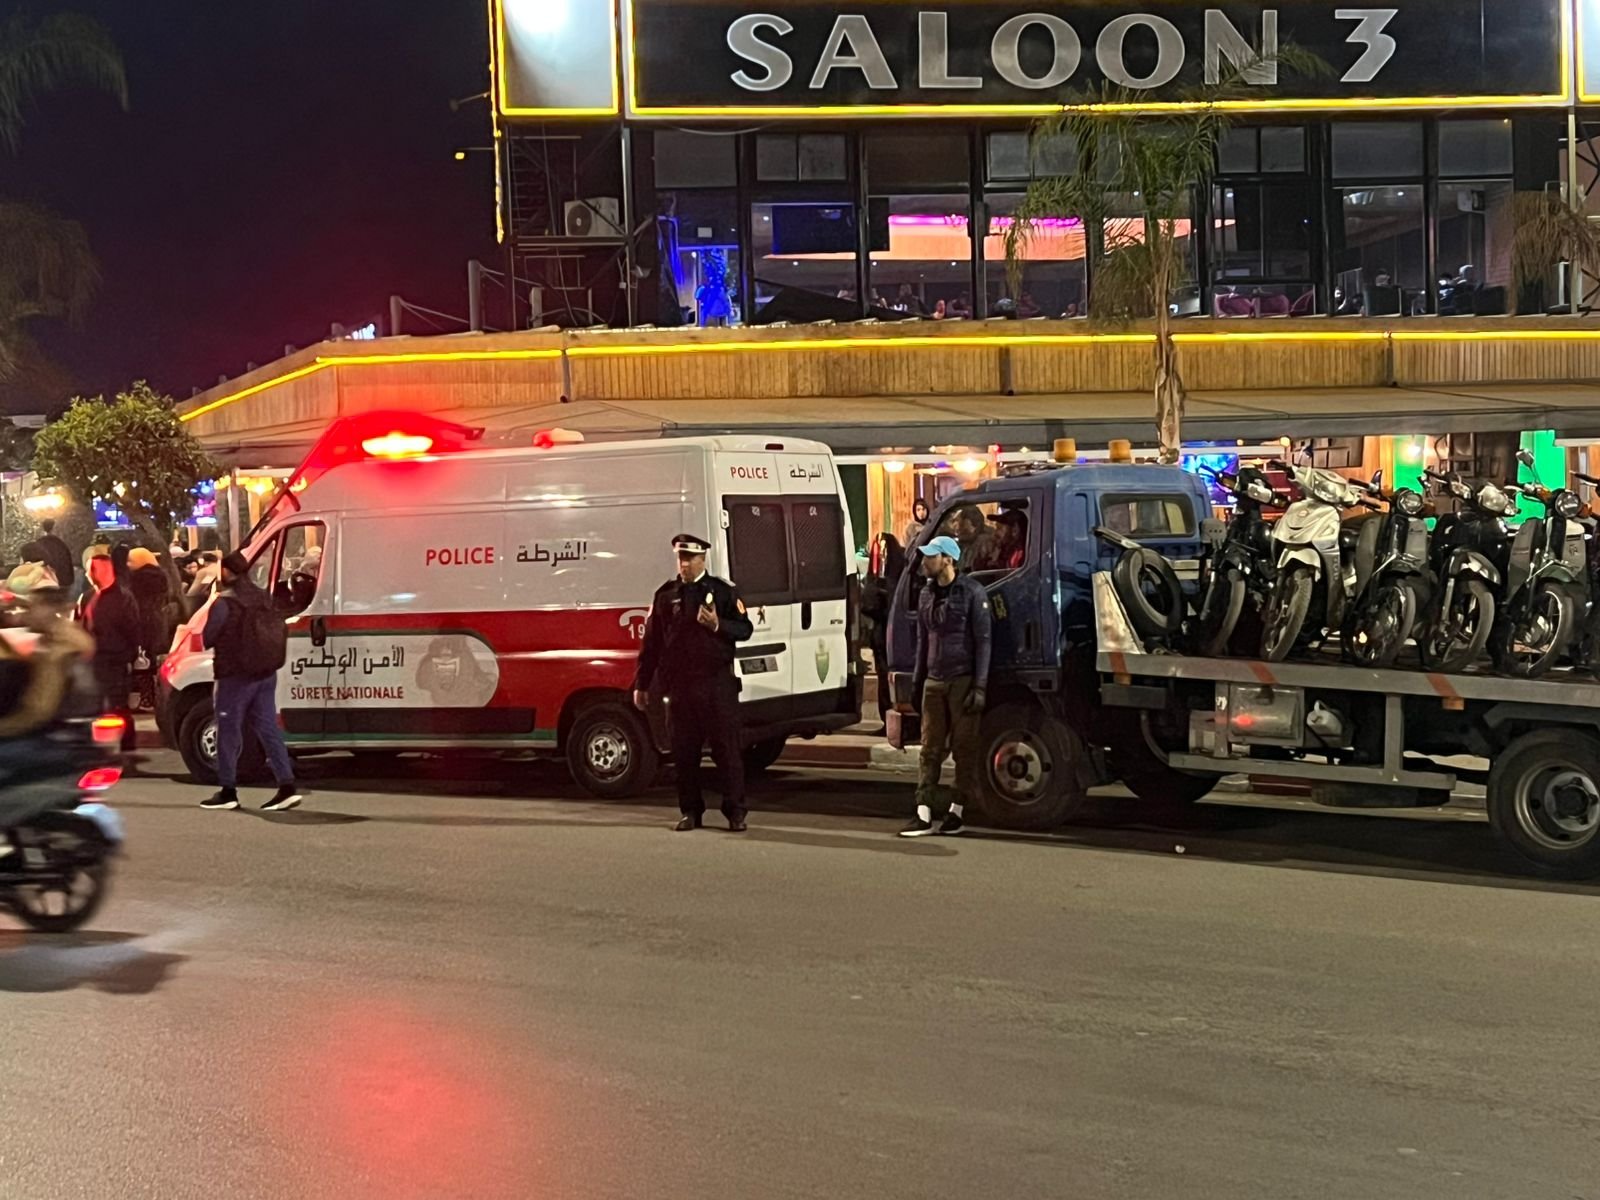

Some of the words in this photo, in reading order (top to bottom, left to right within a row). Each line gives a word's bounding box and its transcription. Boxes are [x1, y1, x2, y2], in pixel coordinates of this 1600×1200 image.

[726, 9, 1279, 91] SALOON
[1334, 8, 1399, 83] 3
[730, 466, 769, 479] POLICE
[789, 464, 825, 483] الشرطة
[426, 547, 494, 566] POLICE
[516, 541, 587, 567] الشرطة
[628, 623, 646, 639] 19
[291, 647, 357, 680] الوطني
[363, 644, 404, 675] الأمن
[336, 685, 404, 700] NATIONALE
